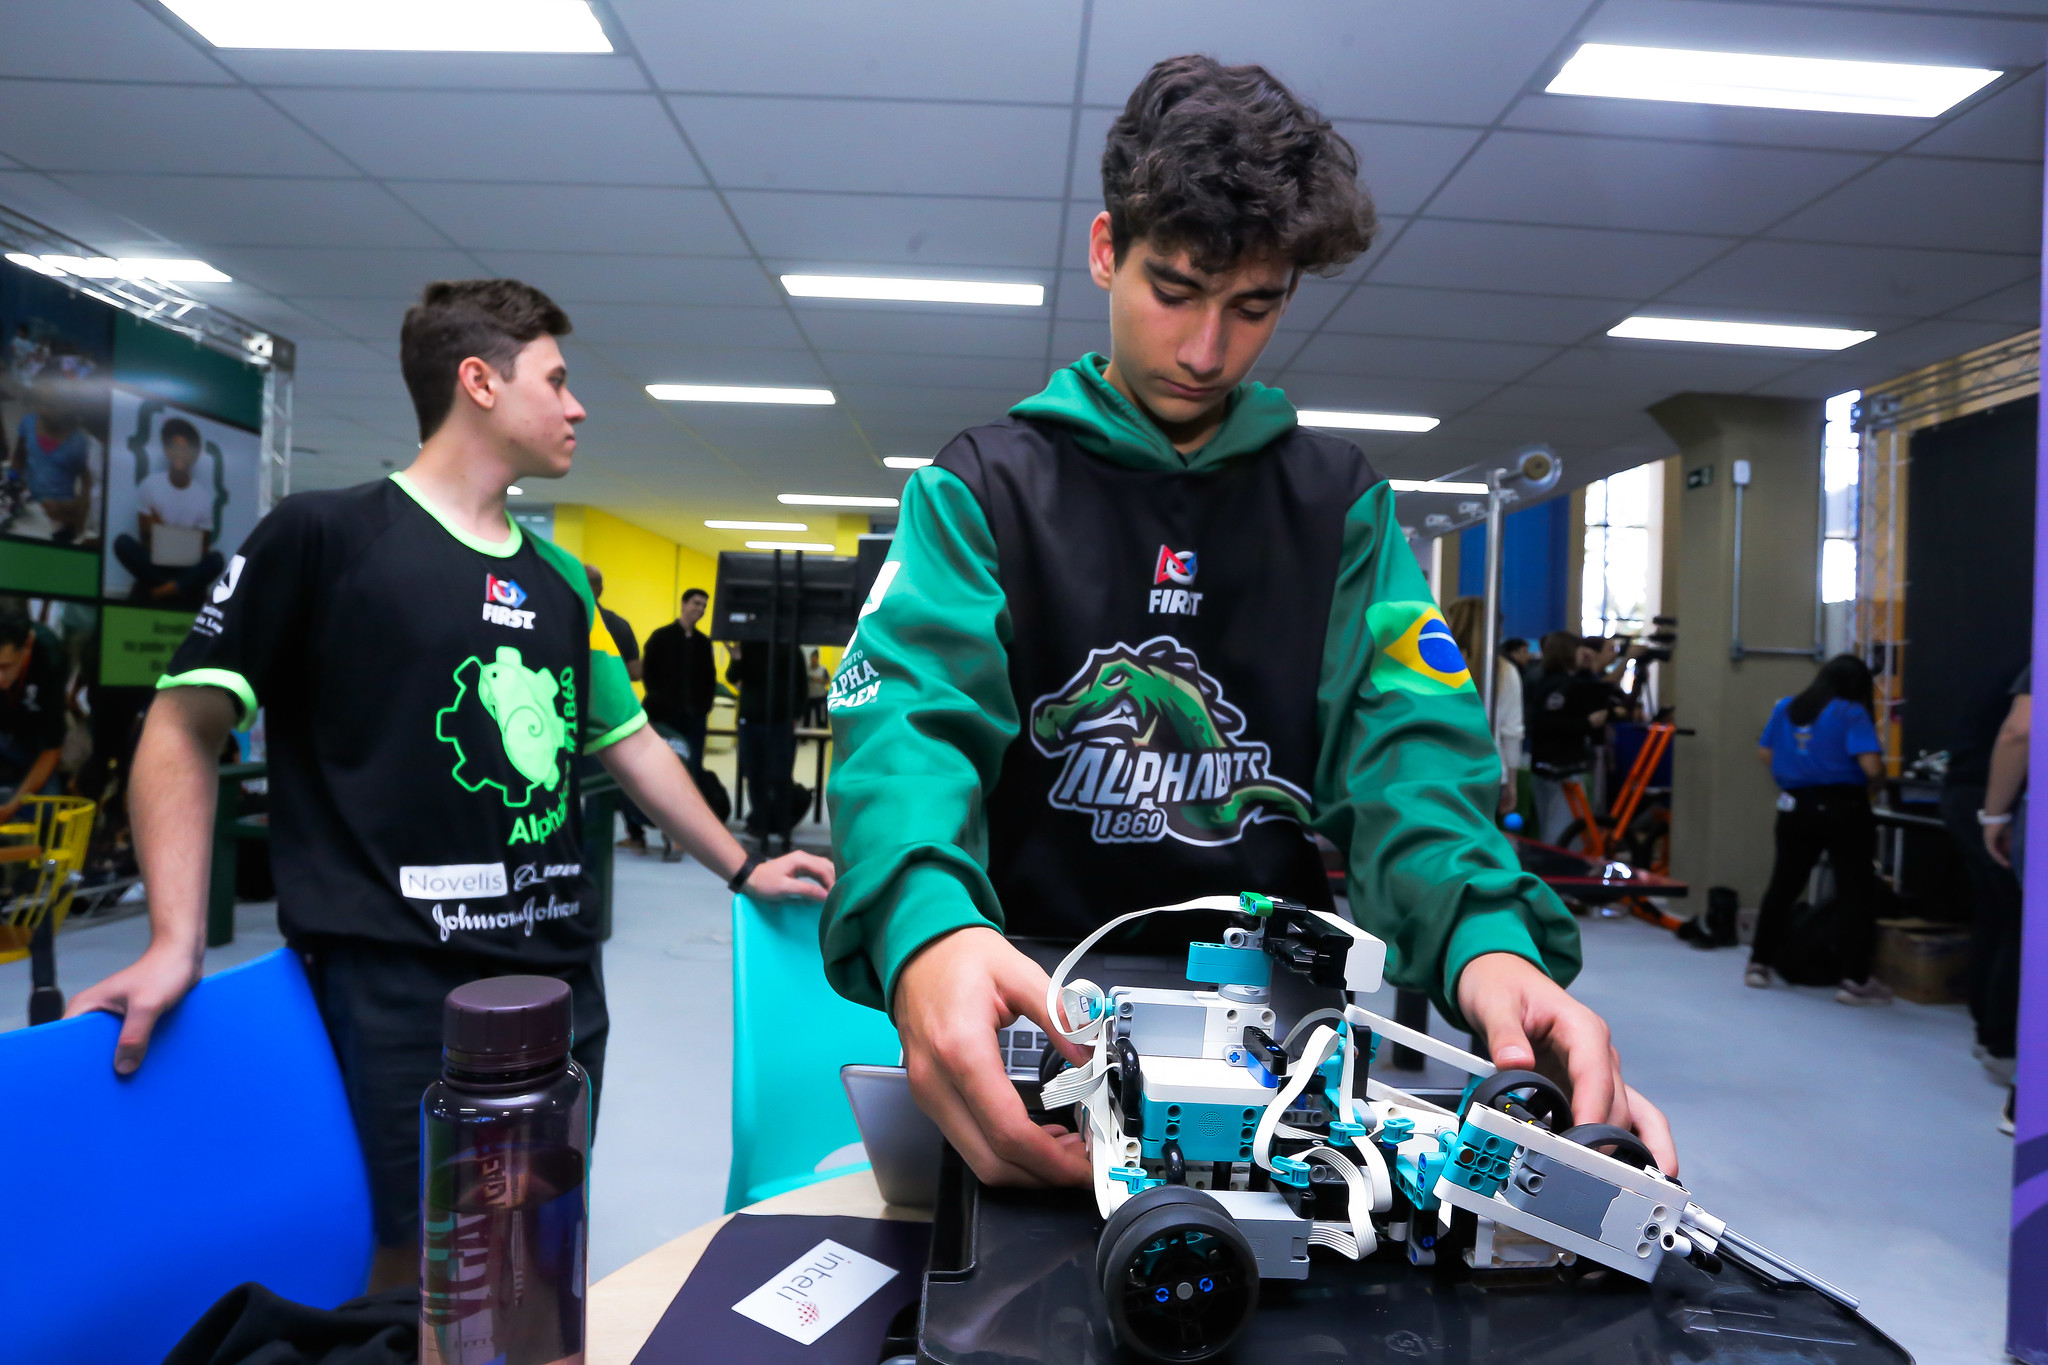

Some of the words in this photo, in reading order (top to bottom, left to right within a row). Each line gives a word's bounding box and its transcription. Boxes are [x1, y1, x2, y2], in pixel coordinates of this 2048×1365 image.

[482, 602, 536, 630] FIRST
[827, 659, 879, 698] LPHA
[1097, 808, 1163, 838] 1860
[407, 872, 504, 893] Novelis
[776, 1252, 852, 1302] inteli
